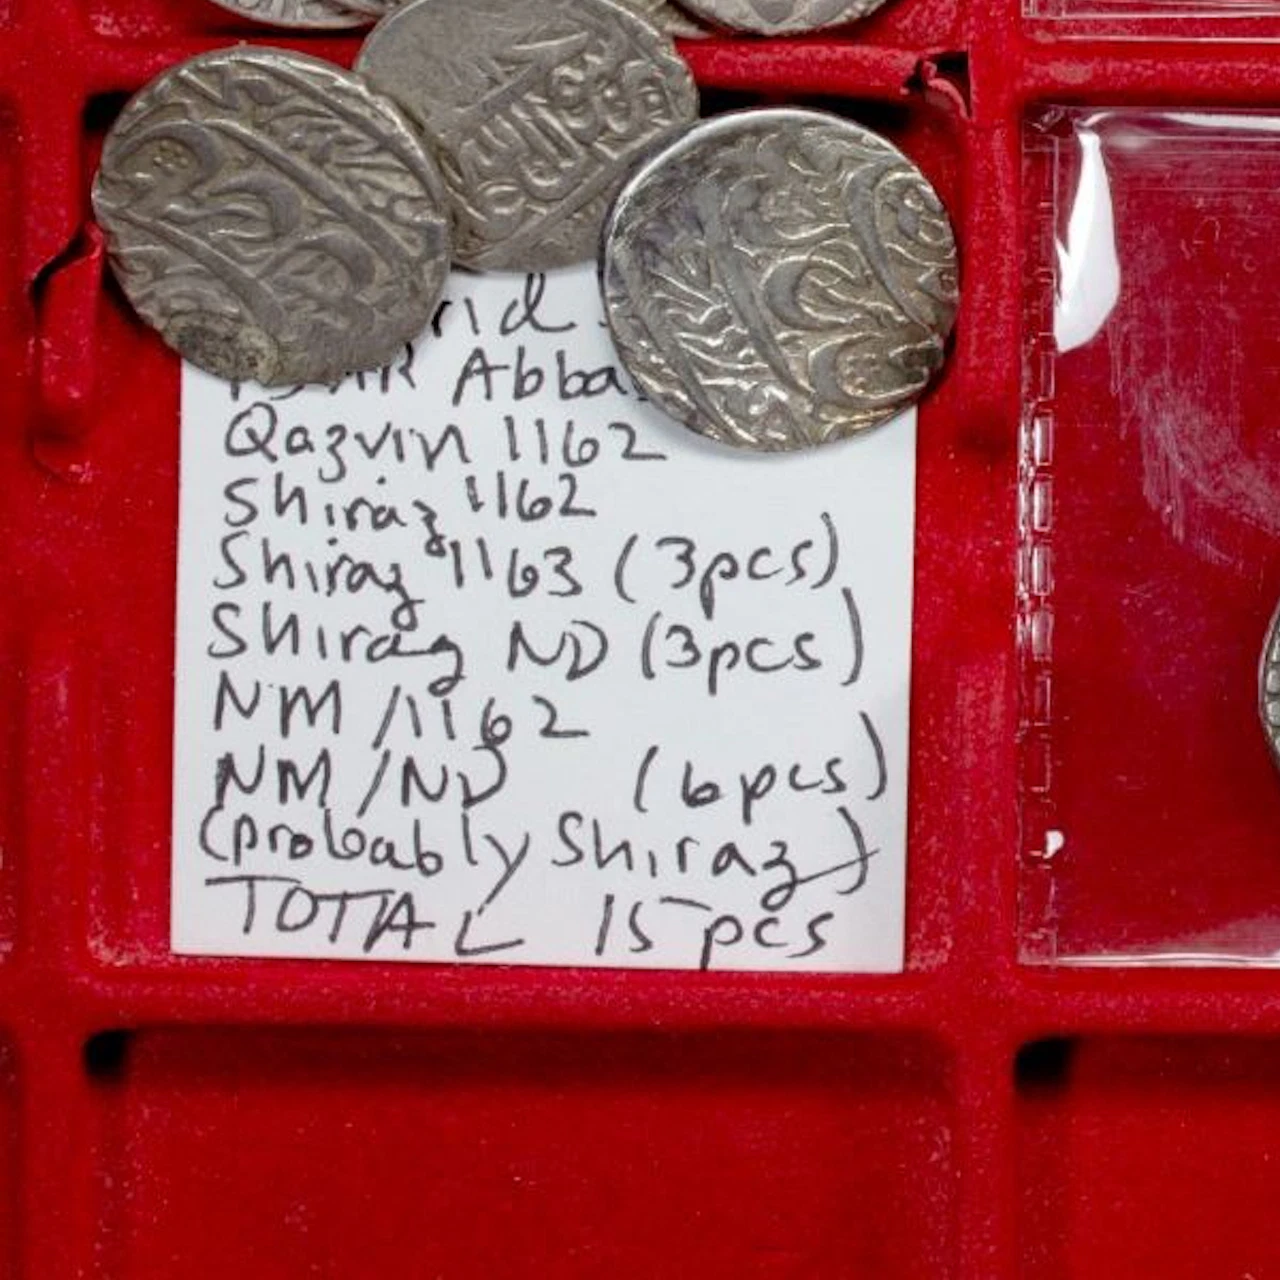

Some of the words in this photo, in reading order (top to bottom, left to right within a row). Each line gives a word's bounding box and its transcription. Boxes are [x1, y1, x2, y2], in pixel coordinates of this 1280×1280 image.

[452, 345, 650, 407] Abba
[224, 402, 469, 482] Qazvin
[504, 416, 668, 467] 1162
[223, 472, 449, 556] Shiraz
[466, 472, 598, 519] 1162
[212, 531, 427, 631] Shiraz
[450, 538, 583, 598] 1163
[614, 511, 839, 619] (3pcs)
[207, 601, 466, 697] Shiraz
[507, 620, 610, 681] ND
[641, 587, 864, 696] (3pcs)
[200, 804, 530, 908] (probably
[552, 807, 880, 910] Shiraz)
[205, 877, 525, 955] TOTAL
[702, 911, 835, 971] pcs
